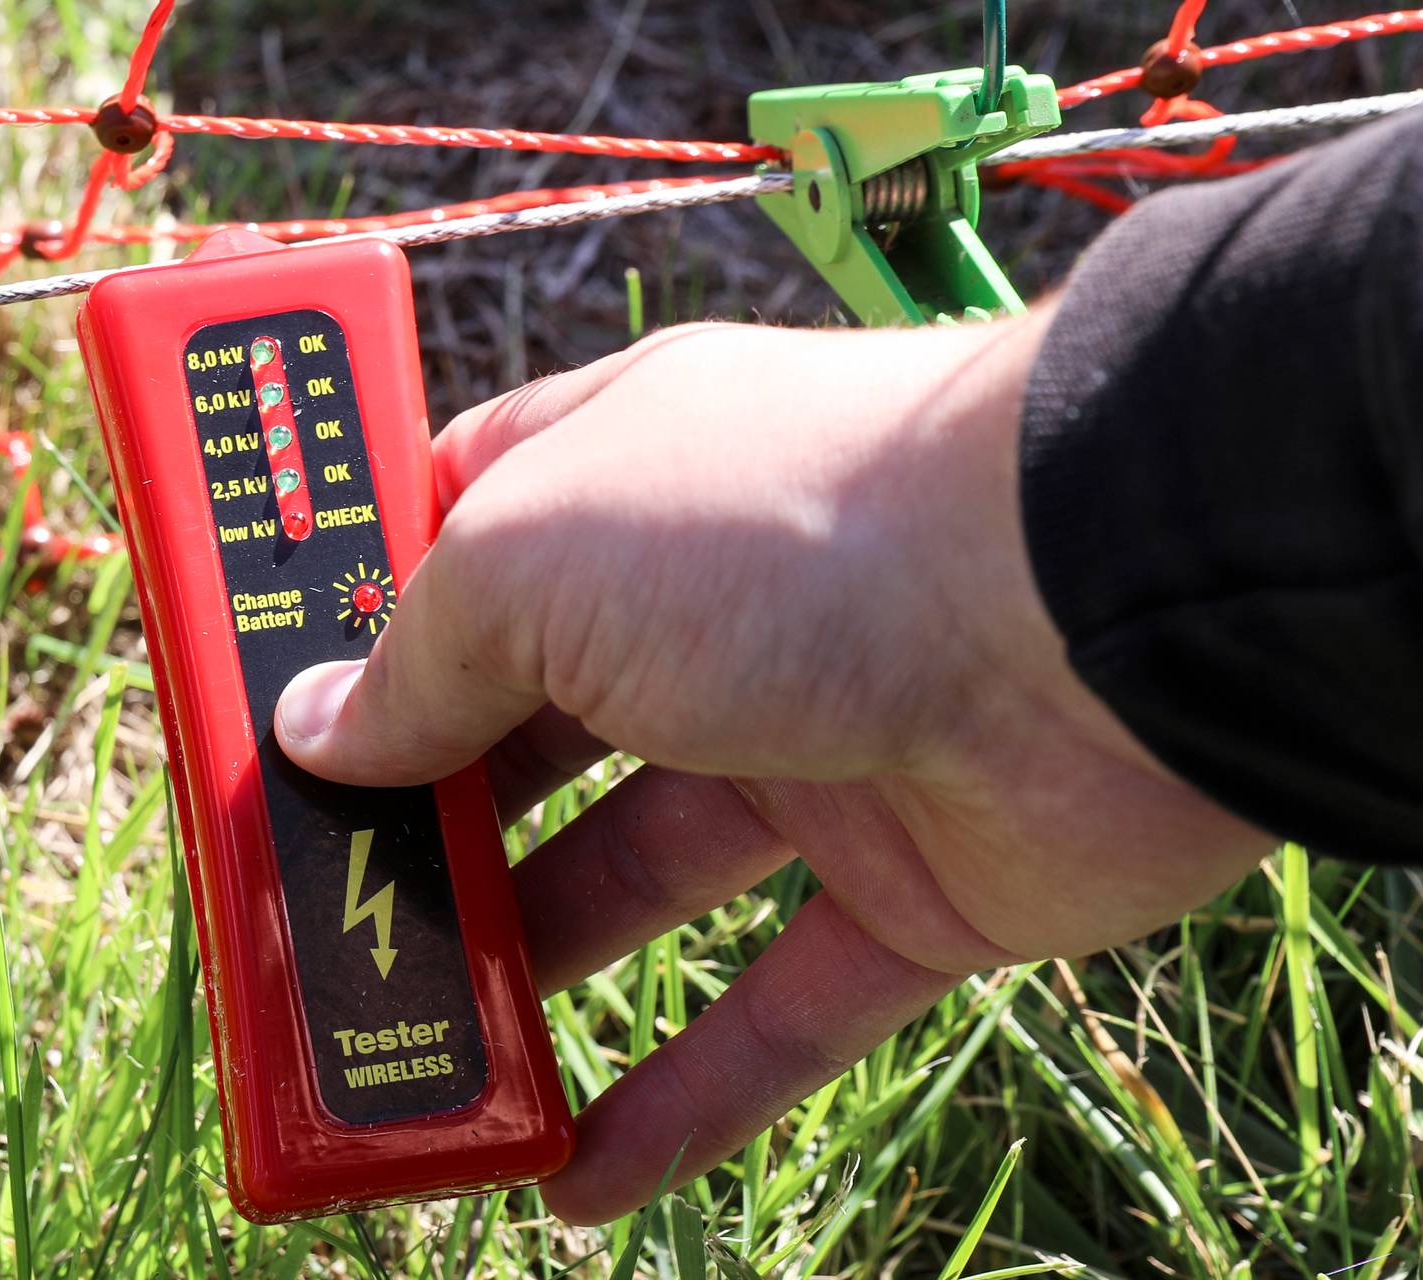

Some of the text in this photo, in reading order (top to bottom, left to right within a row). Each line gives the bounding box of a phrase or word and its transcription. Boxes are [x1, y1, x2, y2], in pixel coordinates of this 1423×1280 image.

[298, 334, 327, 354] OK
[187, 346, 244, 370] 8,0 kV
[307, 377, 336, 397] OK
[194, 389, 252, 414] 6,0 kV
[315, 420, 344, 440] OK
[203, 432, 260, 457] 4,0 kV
[324, 463, 352, 483] OK
[211, 475, 268, 502] 2,5 kV
[315, 504, 377, 529] CHECK
[219, 519, 276, 543] low kV
[232, 588, 303, 613] Change
[236, 609, 306, 632] Battery
[333, 1019, 450, 1057] Tester
[344, 1053, 454, 1089] WIRELESS
